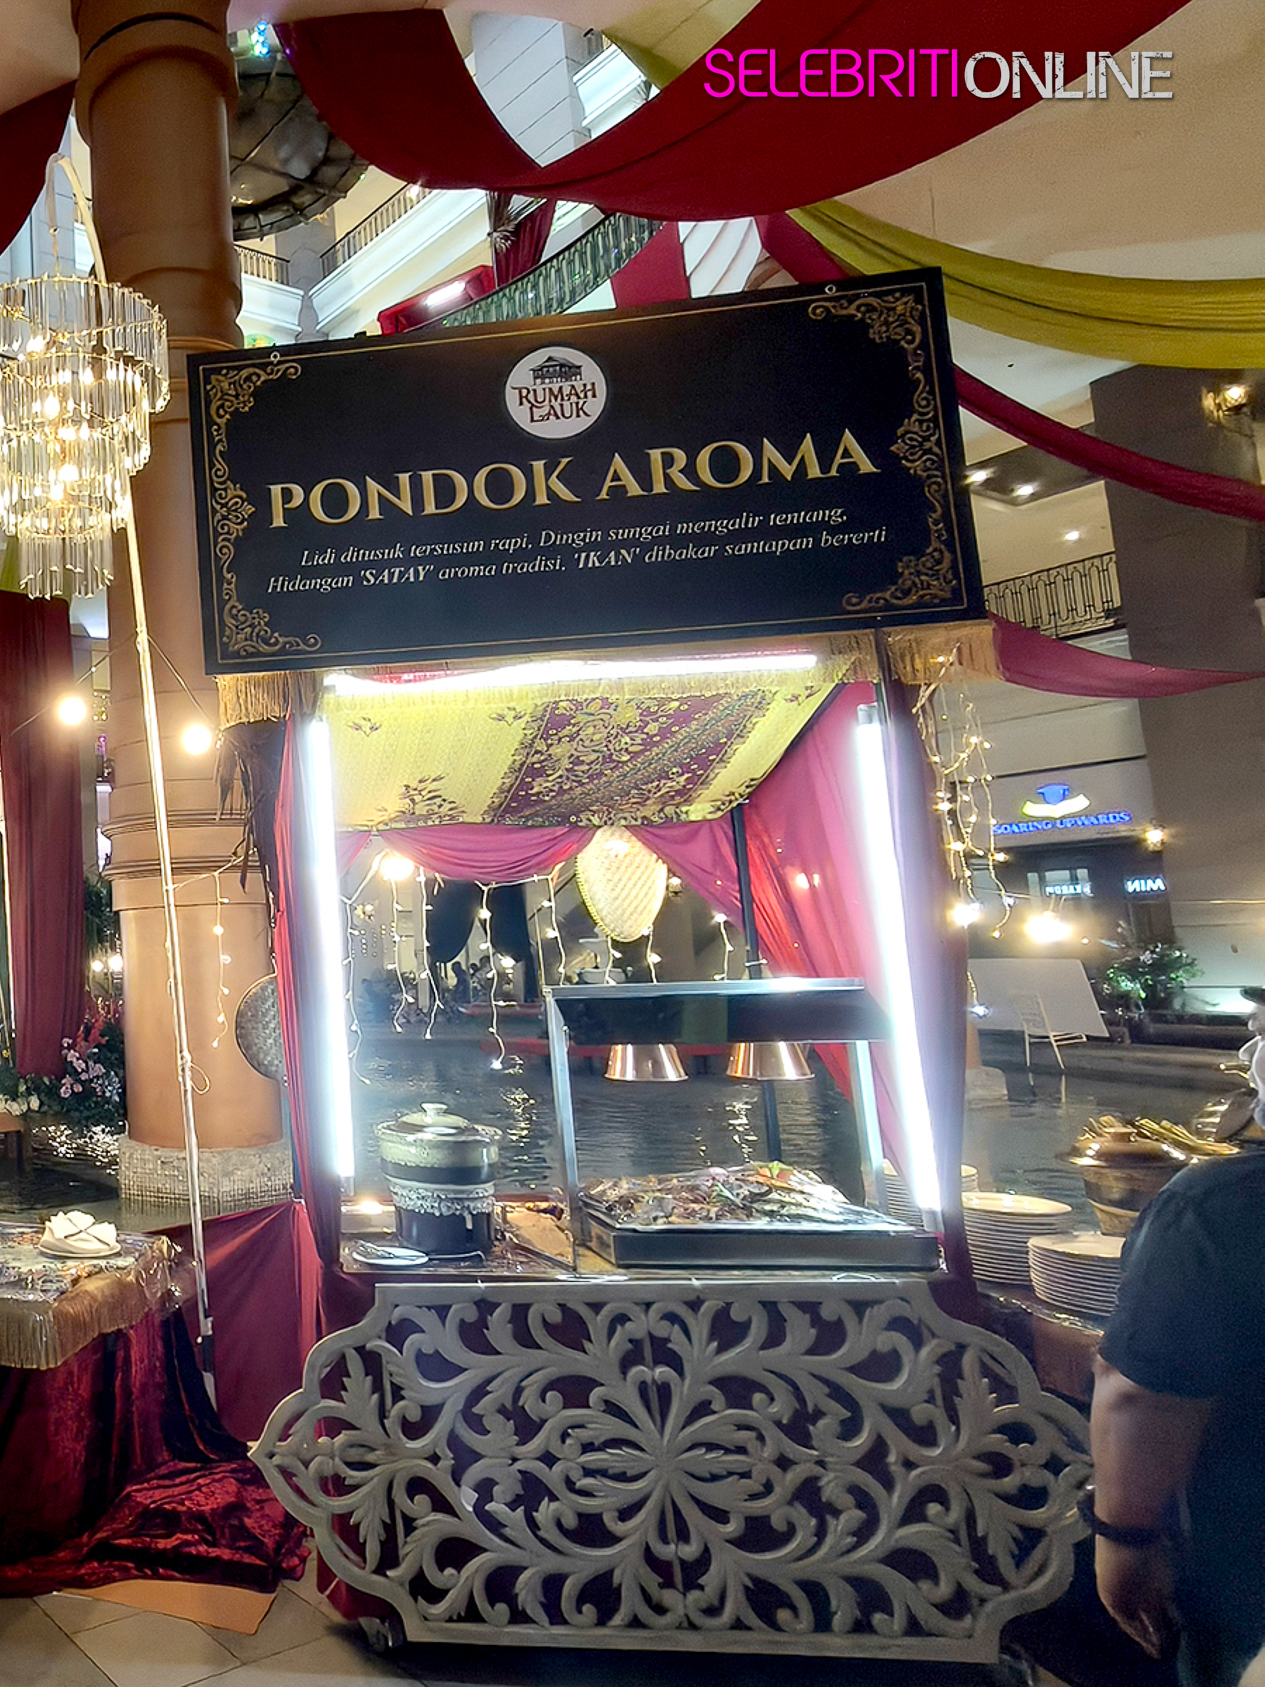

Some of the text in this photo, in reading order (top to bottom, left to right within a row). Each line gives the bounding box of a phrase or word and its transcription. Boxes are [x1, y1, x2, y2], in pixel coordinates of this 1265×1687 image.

[511, 381, 597, 409] RUMAH
[529, 400, 591, 423] LAUK
[267, 428, 881, 529] PONDOK AROMA
[300, 549, 336, 567] Lidi
[339, 542, 405, 564] ditusuk
[409, 540, 484, 558] tersusun
[539, 529, 602, 549] Dingin
[607, 522, 671, 543] sungai
[676, 511, 765, 536] mengalir
[266, 574, 354, 594] Hidangan
[360, 564, 435, 587] 'SATAY'
[438, 563, 497, 580] aroma
[574, 547, 641, 570] 'IKAN'
[644, 541, 719, 564] dibakar
[724, 535, 813, 557] santapan
[820, 527, 887, 549] bererti
[992, 811, 1132, 835] SOARING UPWARDS
